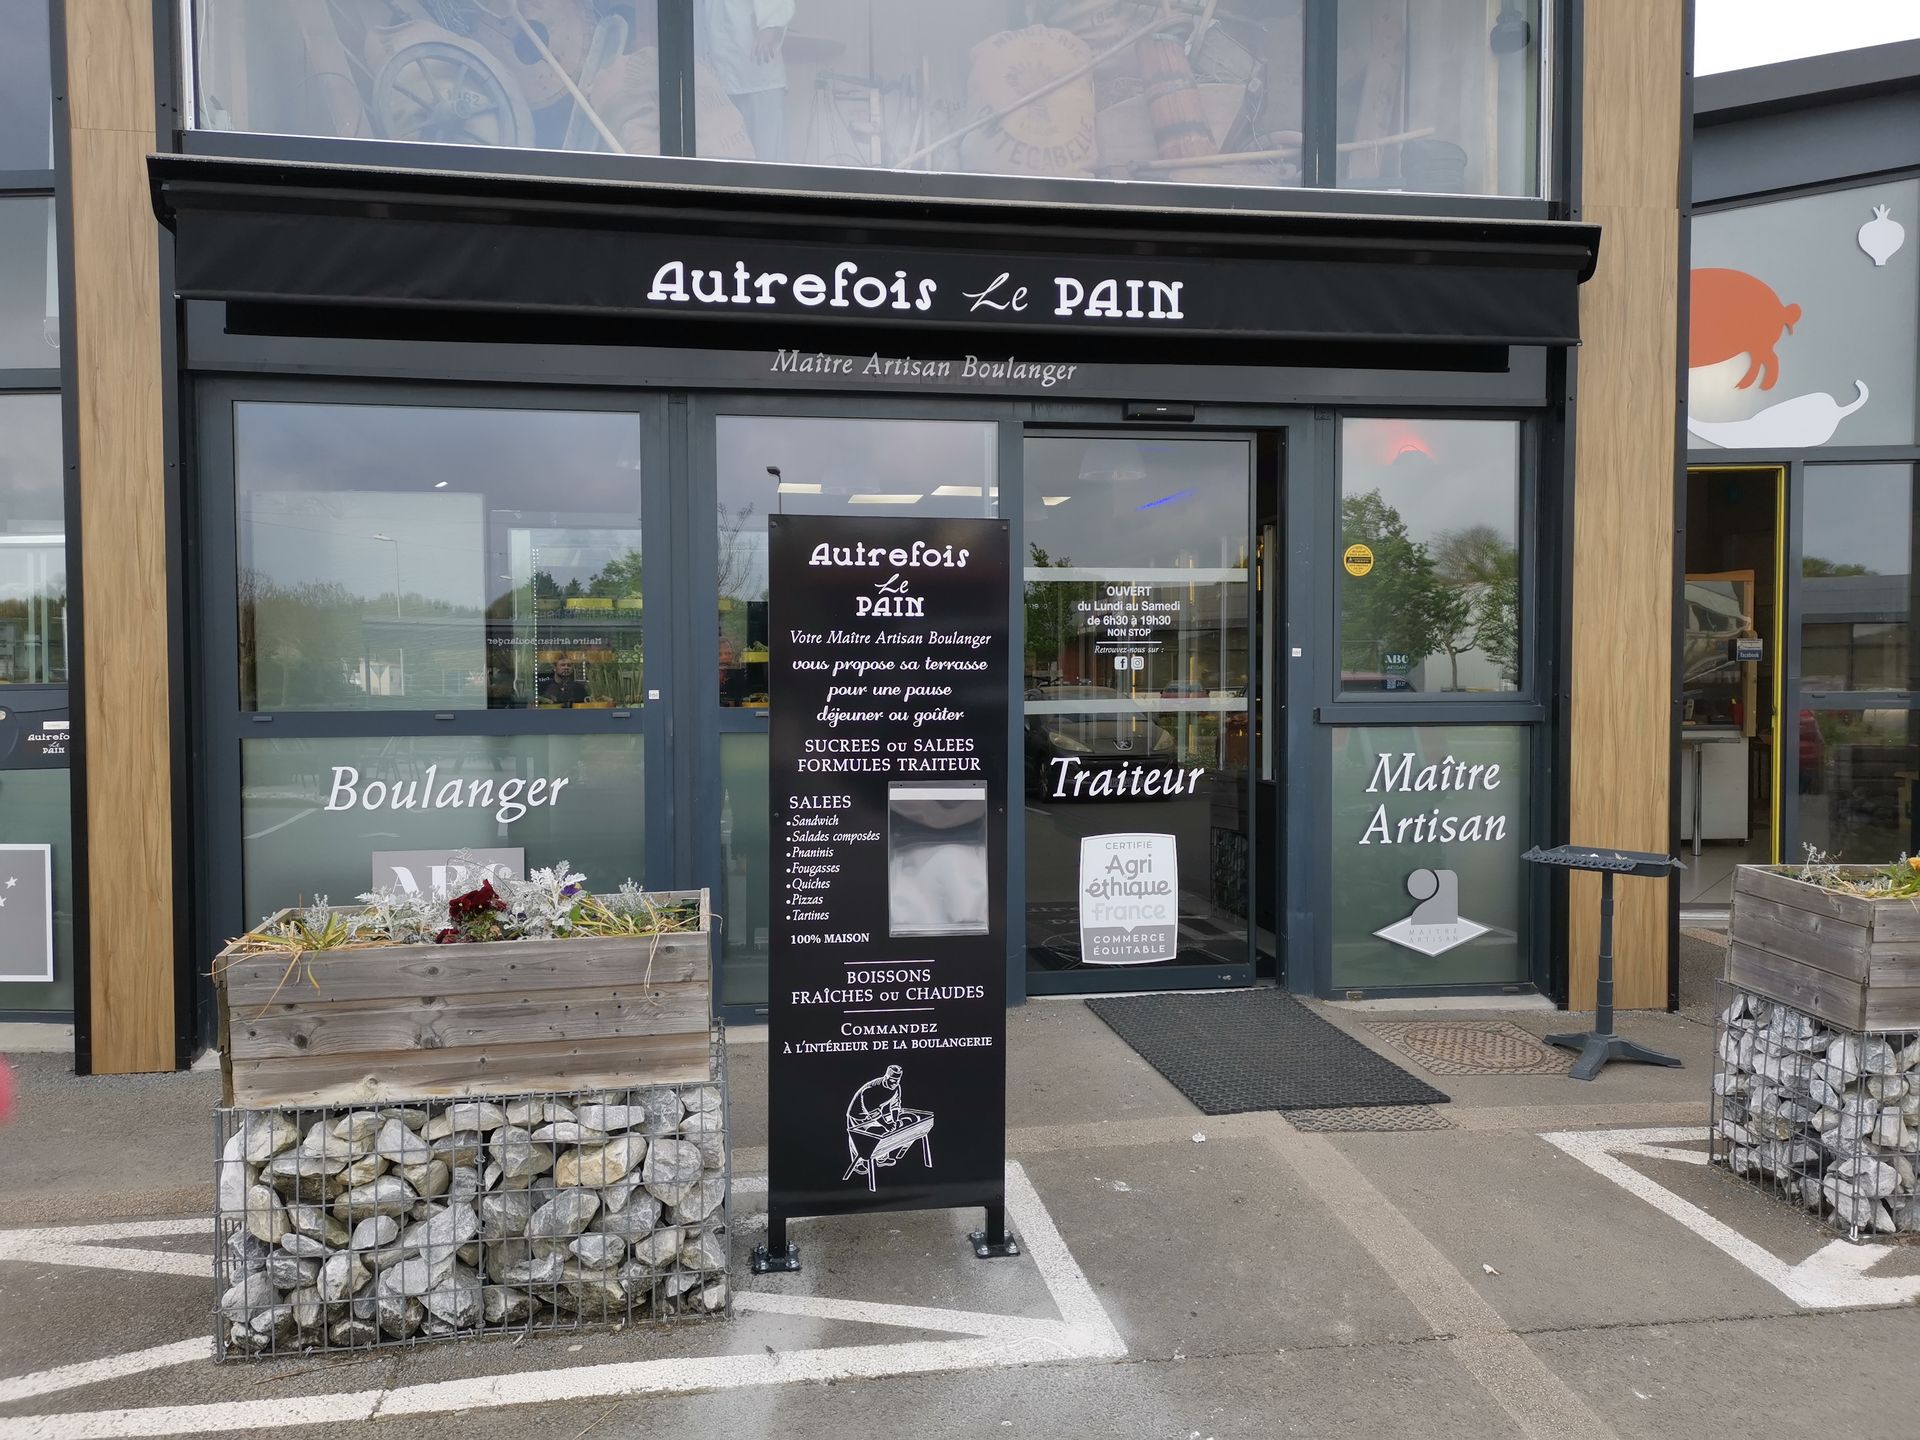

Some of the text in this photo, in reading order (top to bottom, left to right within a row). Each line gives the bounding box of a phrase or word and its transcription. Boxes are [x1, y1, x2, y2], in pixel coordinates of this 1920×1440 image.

[647, 261, 1184, 319] Autrefois Le PAIN
[770, 348, 1078, 387] Maître Artisan Boulanger
[809, 541, 969, 567] Autrefois
[875, 574, 908, 594] Le
[1107, 586, 1152, 597] OUVERT
[856, 597, 924, 616] PAIN
[1078, 601, 1181, 611] du Lundi au Samedi
[1087, 615, 1171, 626] de 6h30 à 19h30
[791, 630, 991, 648] Votre Maître Artisan Boulanger
[1094, 645, 1146, 654] Retrouvez-nous
[1148, 646, 1159, 654] sur
[793, 657, 988, 676] vous propose sa terrasse
[1384, 654, 1409, 664] ABC
[827, 686, 952, 702] pour une pause
[817, 705, 964, 727] déjeuner ou goûter
[27, 732, 70, 741] Autrefo
[805, 739, 880, 752] SUCREES
[914, 739, 974, 751] SALEES
[798, 758, 981, 772] FORMULES TRAITEUR
[1365, 752, 1501, 793] Maître
[1050, 757, 1204, 797] Traiteur
[324, 764, 568, 823] Boulanger
[790, 795, 851, 809] SALEES
[792, 814, 838, 826] Sandwich
[1359, 804, 1506, 845] Artisan
[792, 830, 880, 845] Salades composées
[792, 847, 834, 857] Pnaninis
[1105, 841, 1153, 850] CERTIFIÉ
[792, 862, 840, 877] Fougasses
[1105, 854, 1152, 880] Agri
[792, 877, 830, 891] Quiches
[1085, 877, 1172, 900] éthique
[792, 894, 823, 905] Pizzas
[793, 910, 829, 920] Tartines
[791, 933, 869, 944] 100% MAISON
[1093, 933, 1165, 943] COMMERCE
[1093, 945, 1165, 956] ÉQUITABLE
[847, 969, 930, 984] BOISSONS
[792, 988, 873, 1004] FRAÎCHES
[906, 986, 984, 1000] CHAUDES
[783, 1042, 792, 1053] À
[873, 1041, 888, 1050] DE
[893, 1040, 907, 1049] LA
[911, 1037, 992, 1048] BOULANGERIE
